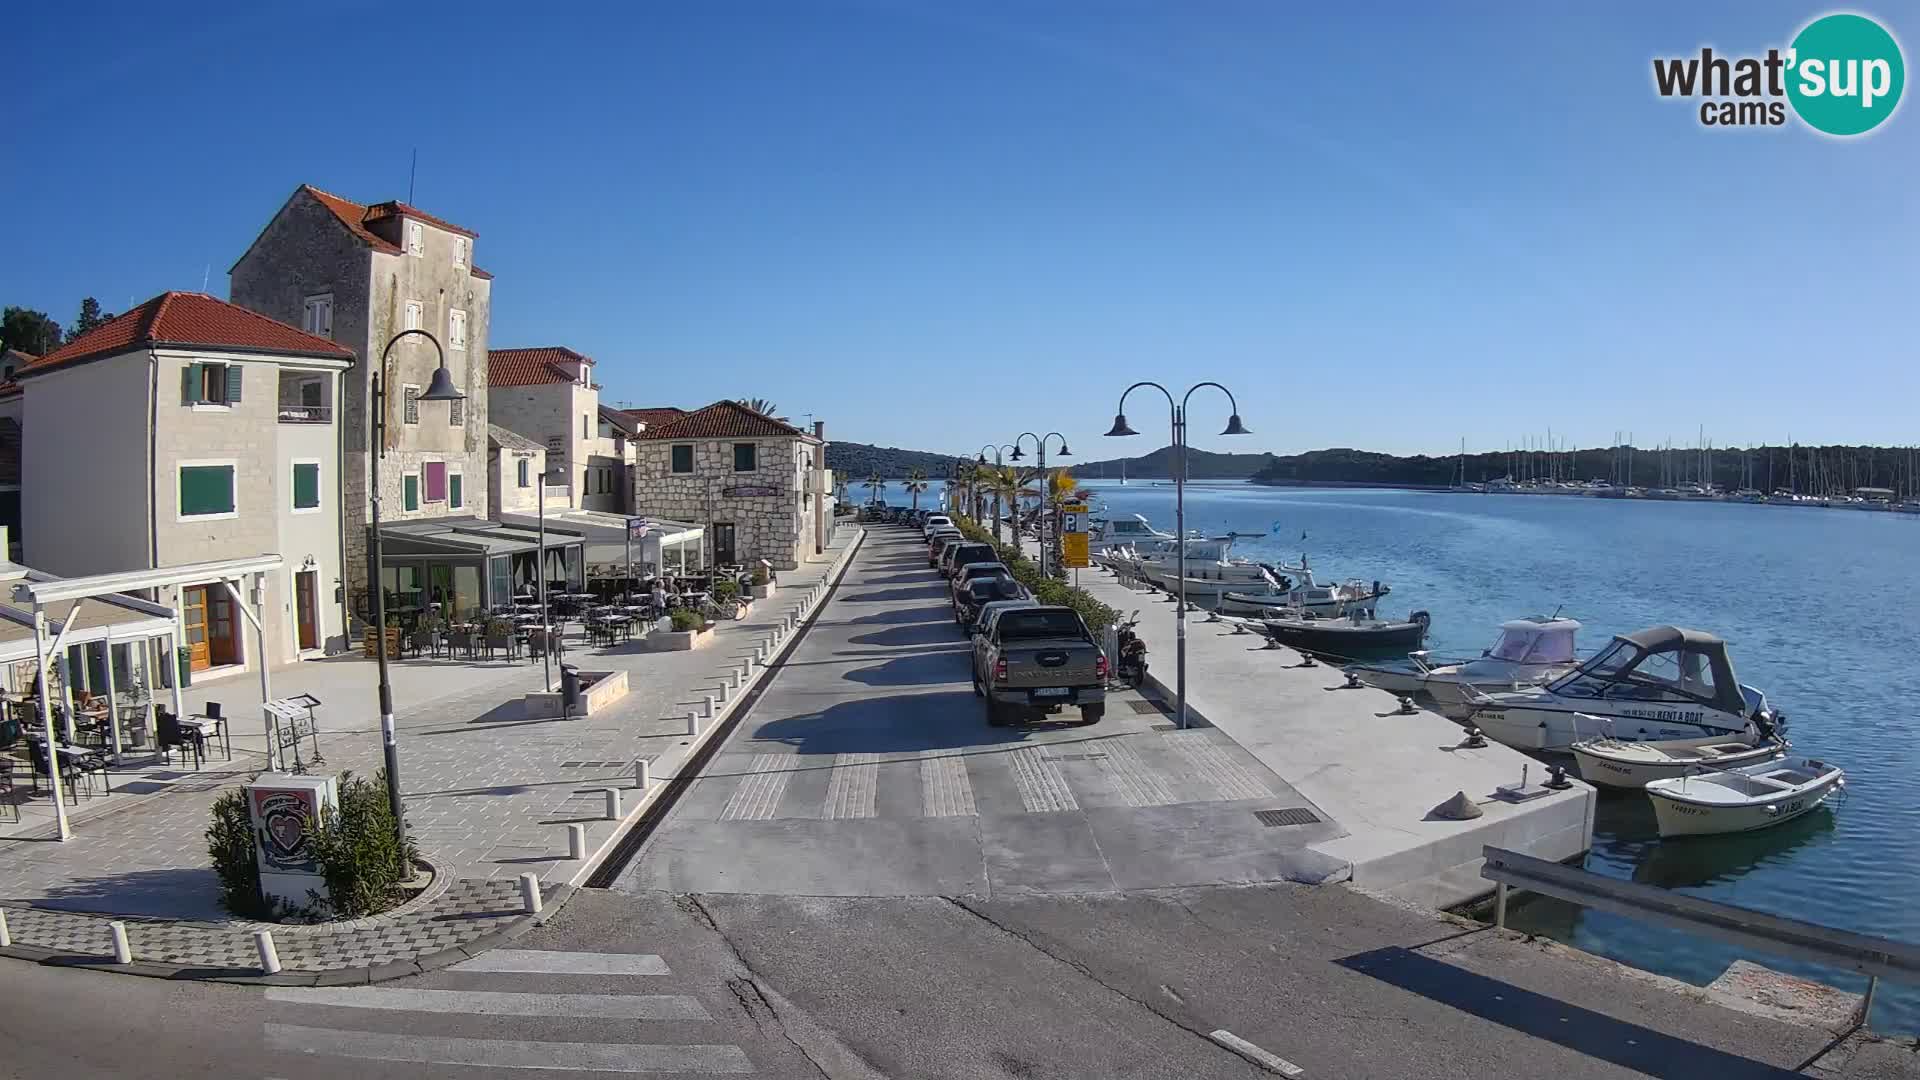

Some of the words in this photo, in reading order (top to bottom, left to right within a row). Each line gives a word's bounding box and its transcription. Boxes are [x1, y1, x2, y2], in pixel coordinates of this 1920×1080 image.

[1065, 515, 1075, 530] P
[1657, 711, 1677, 720] RENT
[1678, 711, 1683, 721] A
[1685, 711, 1704, 723] BOAT
